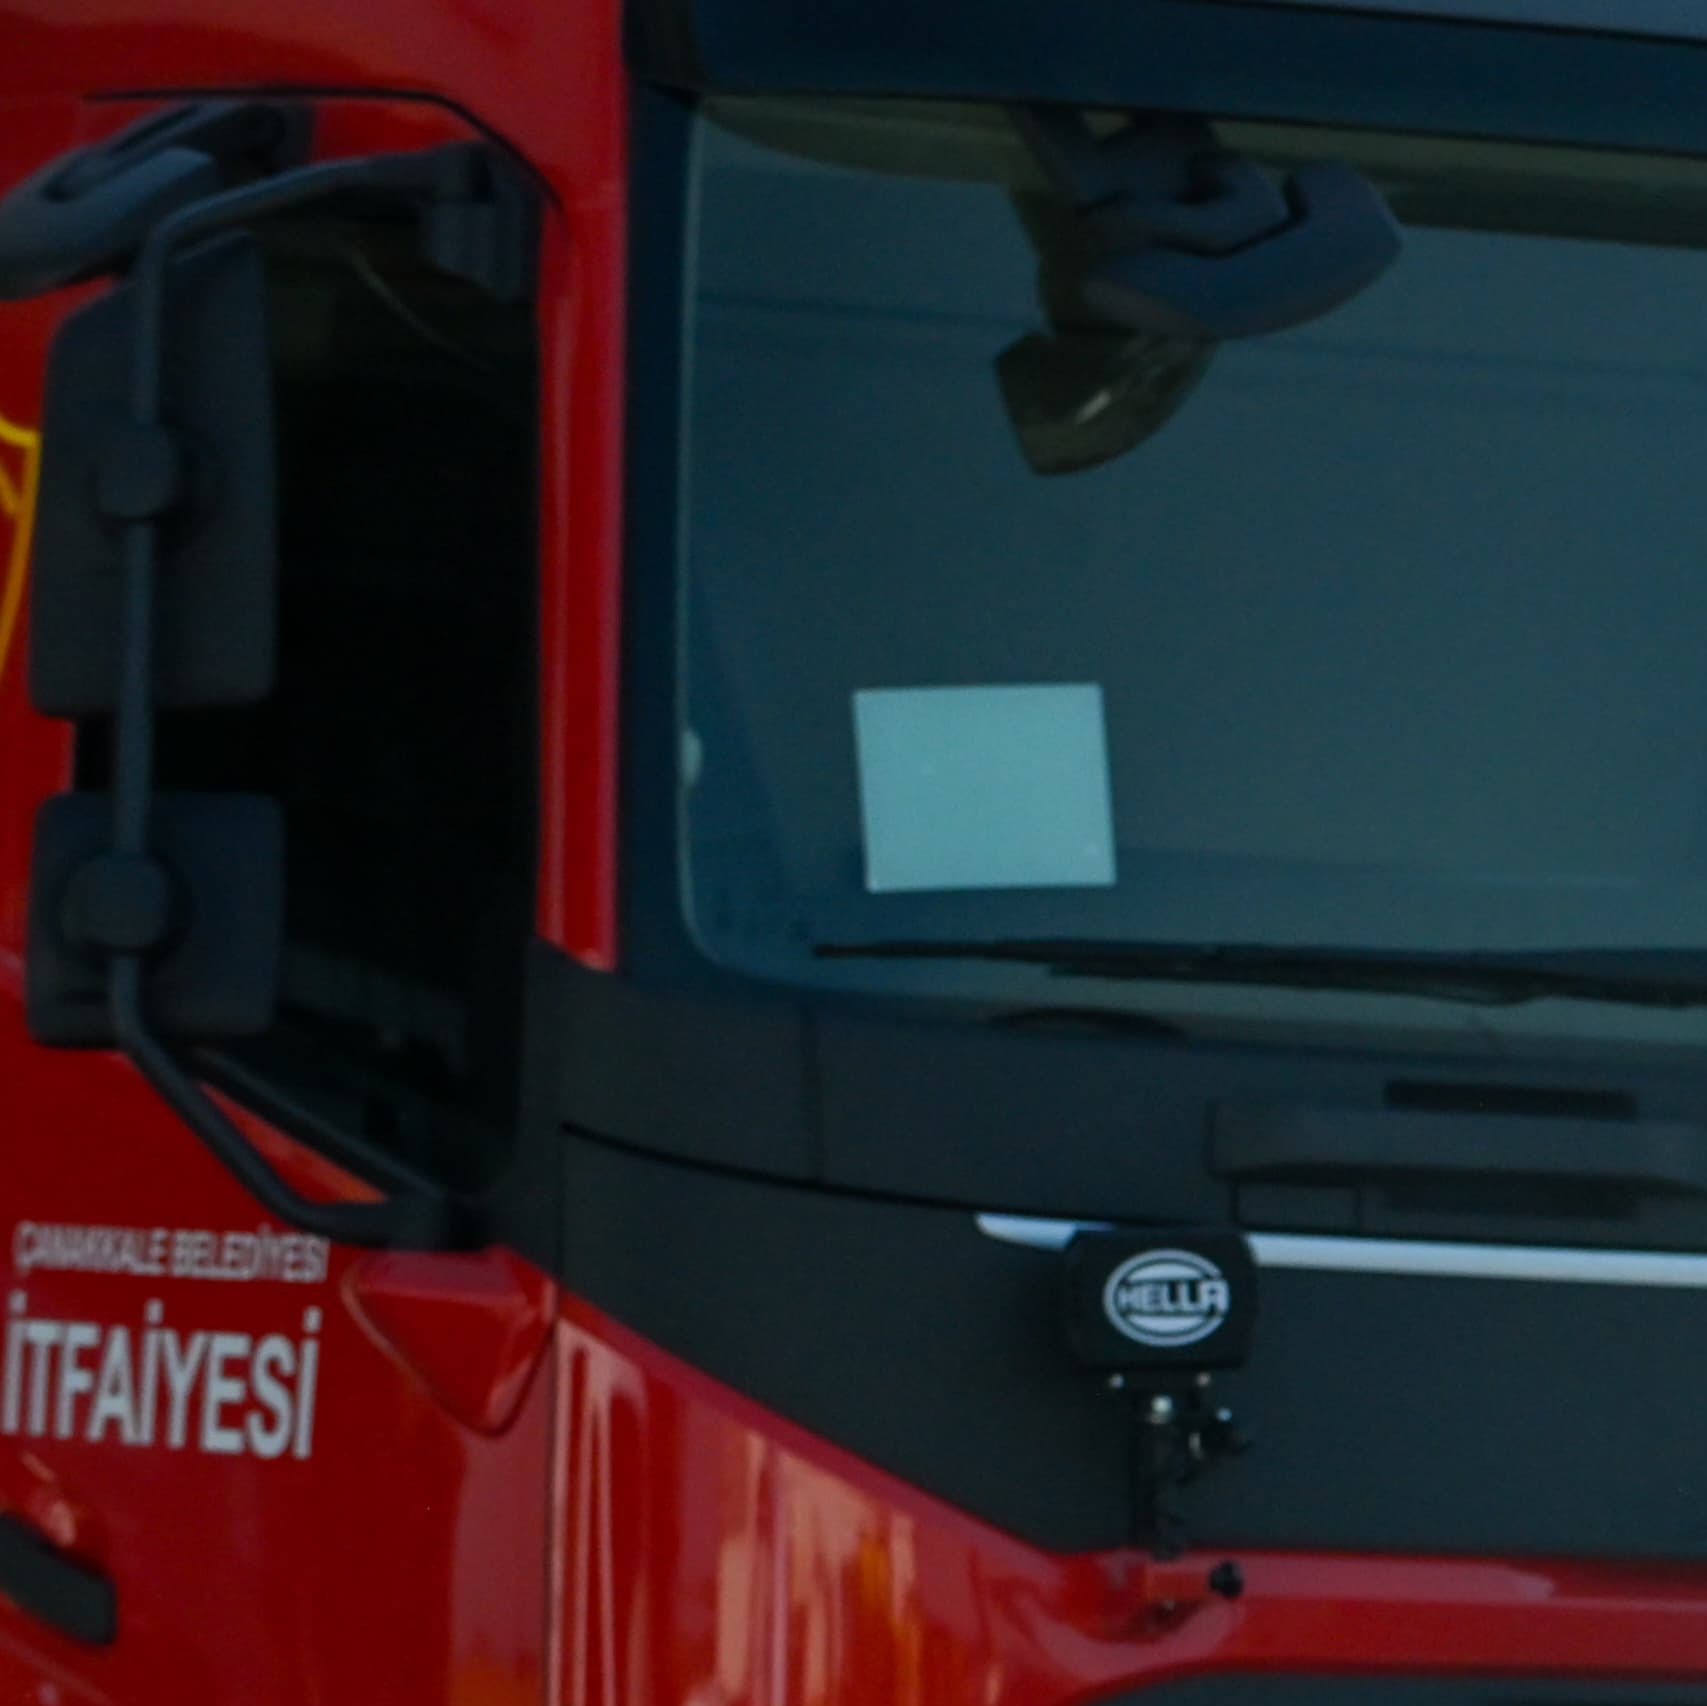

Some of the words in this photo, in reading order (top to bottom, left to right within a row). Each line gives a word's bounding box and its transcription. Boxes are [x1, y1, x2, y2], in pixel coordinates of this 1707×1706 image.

[13, 1220, 168, 1277] ÇANAKKALE
[1115, 1279, 1230, 1314] HELLA
[1, 1289, 322, 1460] İTFAİYESİ
